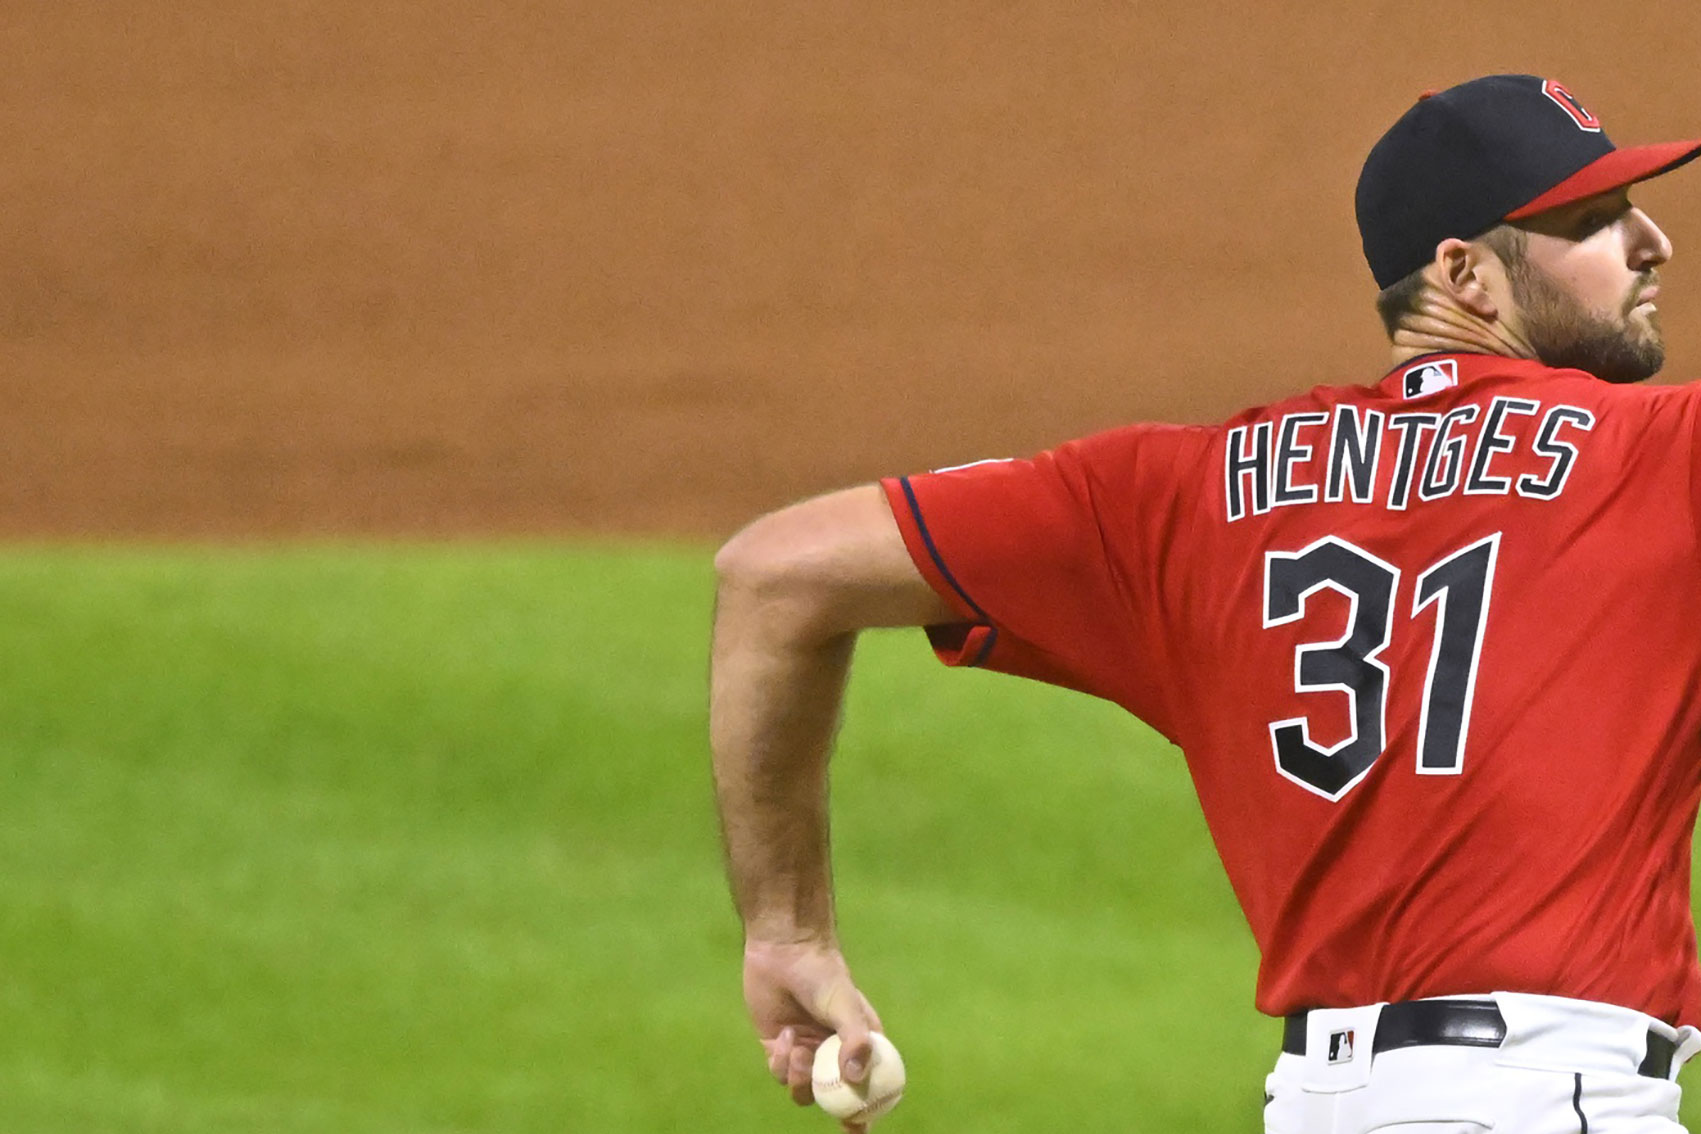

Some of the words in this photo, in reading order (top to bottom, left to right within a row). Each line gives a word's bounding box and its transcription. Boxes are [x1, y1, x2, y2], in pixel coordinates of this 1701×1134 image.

[1541, 79, 1601, 133] C
[1225, 396, 1597, 523] HENTGES
[1262, 531, 1503, 803] 31
